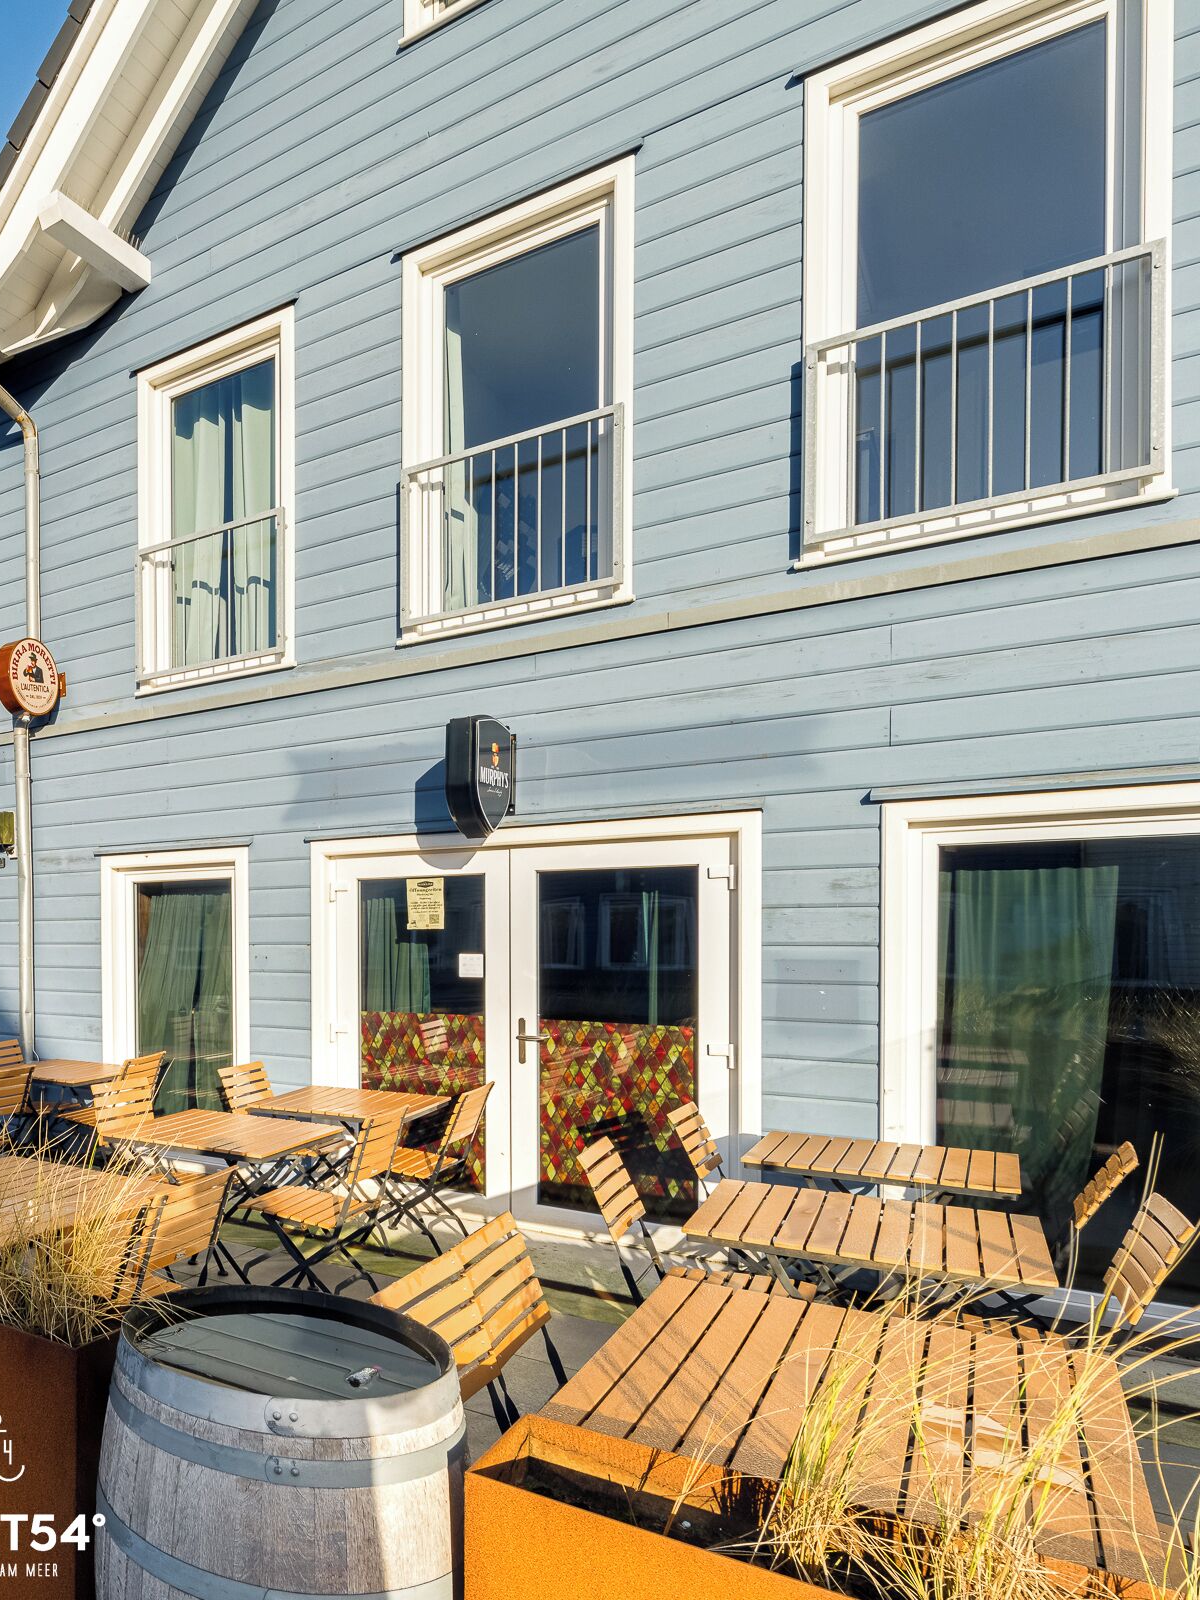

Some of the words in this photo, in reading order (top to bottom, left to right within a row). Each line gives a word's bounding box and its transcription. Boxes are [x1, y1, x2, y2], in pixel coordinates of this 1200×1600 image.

[12, 645, 27, 680] BIRRA
[27, 643, 56, 685] MORETTI
[20, 683, 50, 693] L'AUTENTICA
[480, 766, 509, 788] MURPHY'S
